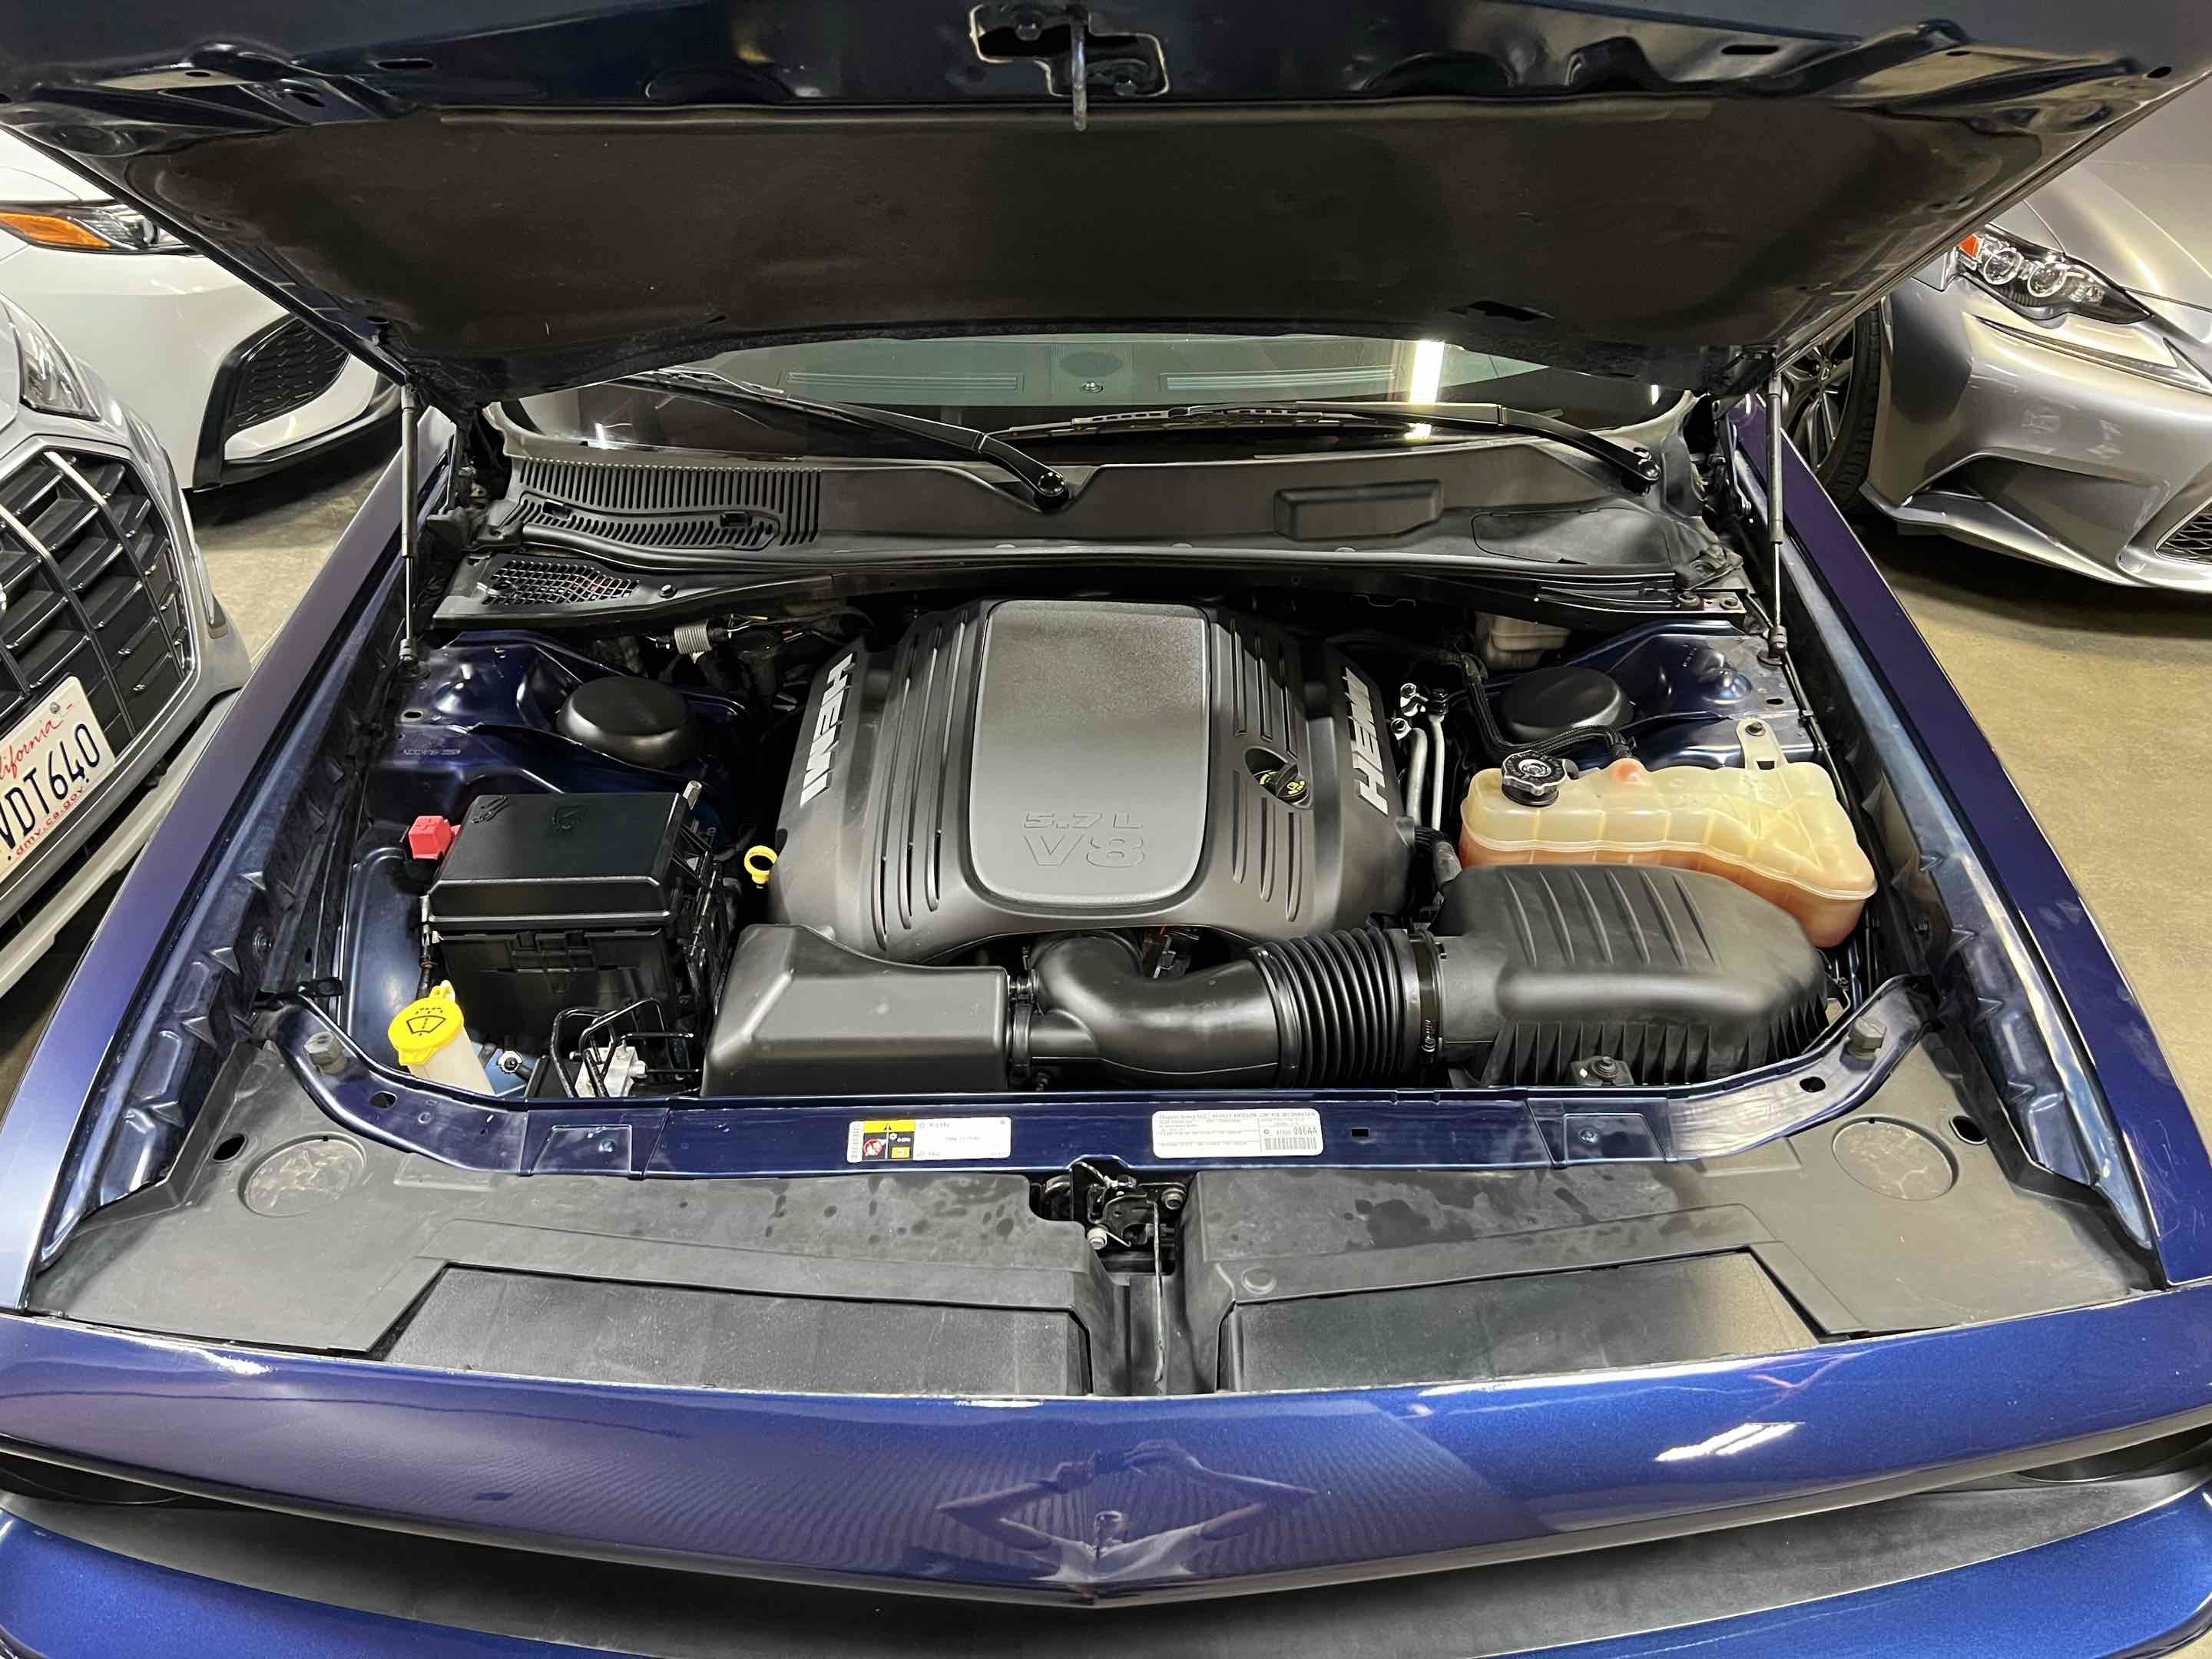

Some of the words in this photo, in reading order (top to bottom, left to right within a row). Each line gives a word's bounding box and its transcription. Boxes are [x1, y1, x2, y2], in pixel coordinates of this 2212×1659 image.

[800, 653, 853, 808] HEMI
[1346, 667, 1389, 817] HEMI
[15, 785, 84, 856] dmv.ca.gov
[1023, 834, 1145, 869] V8
